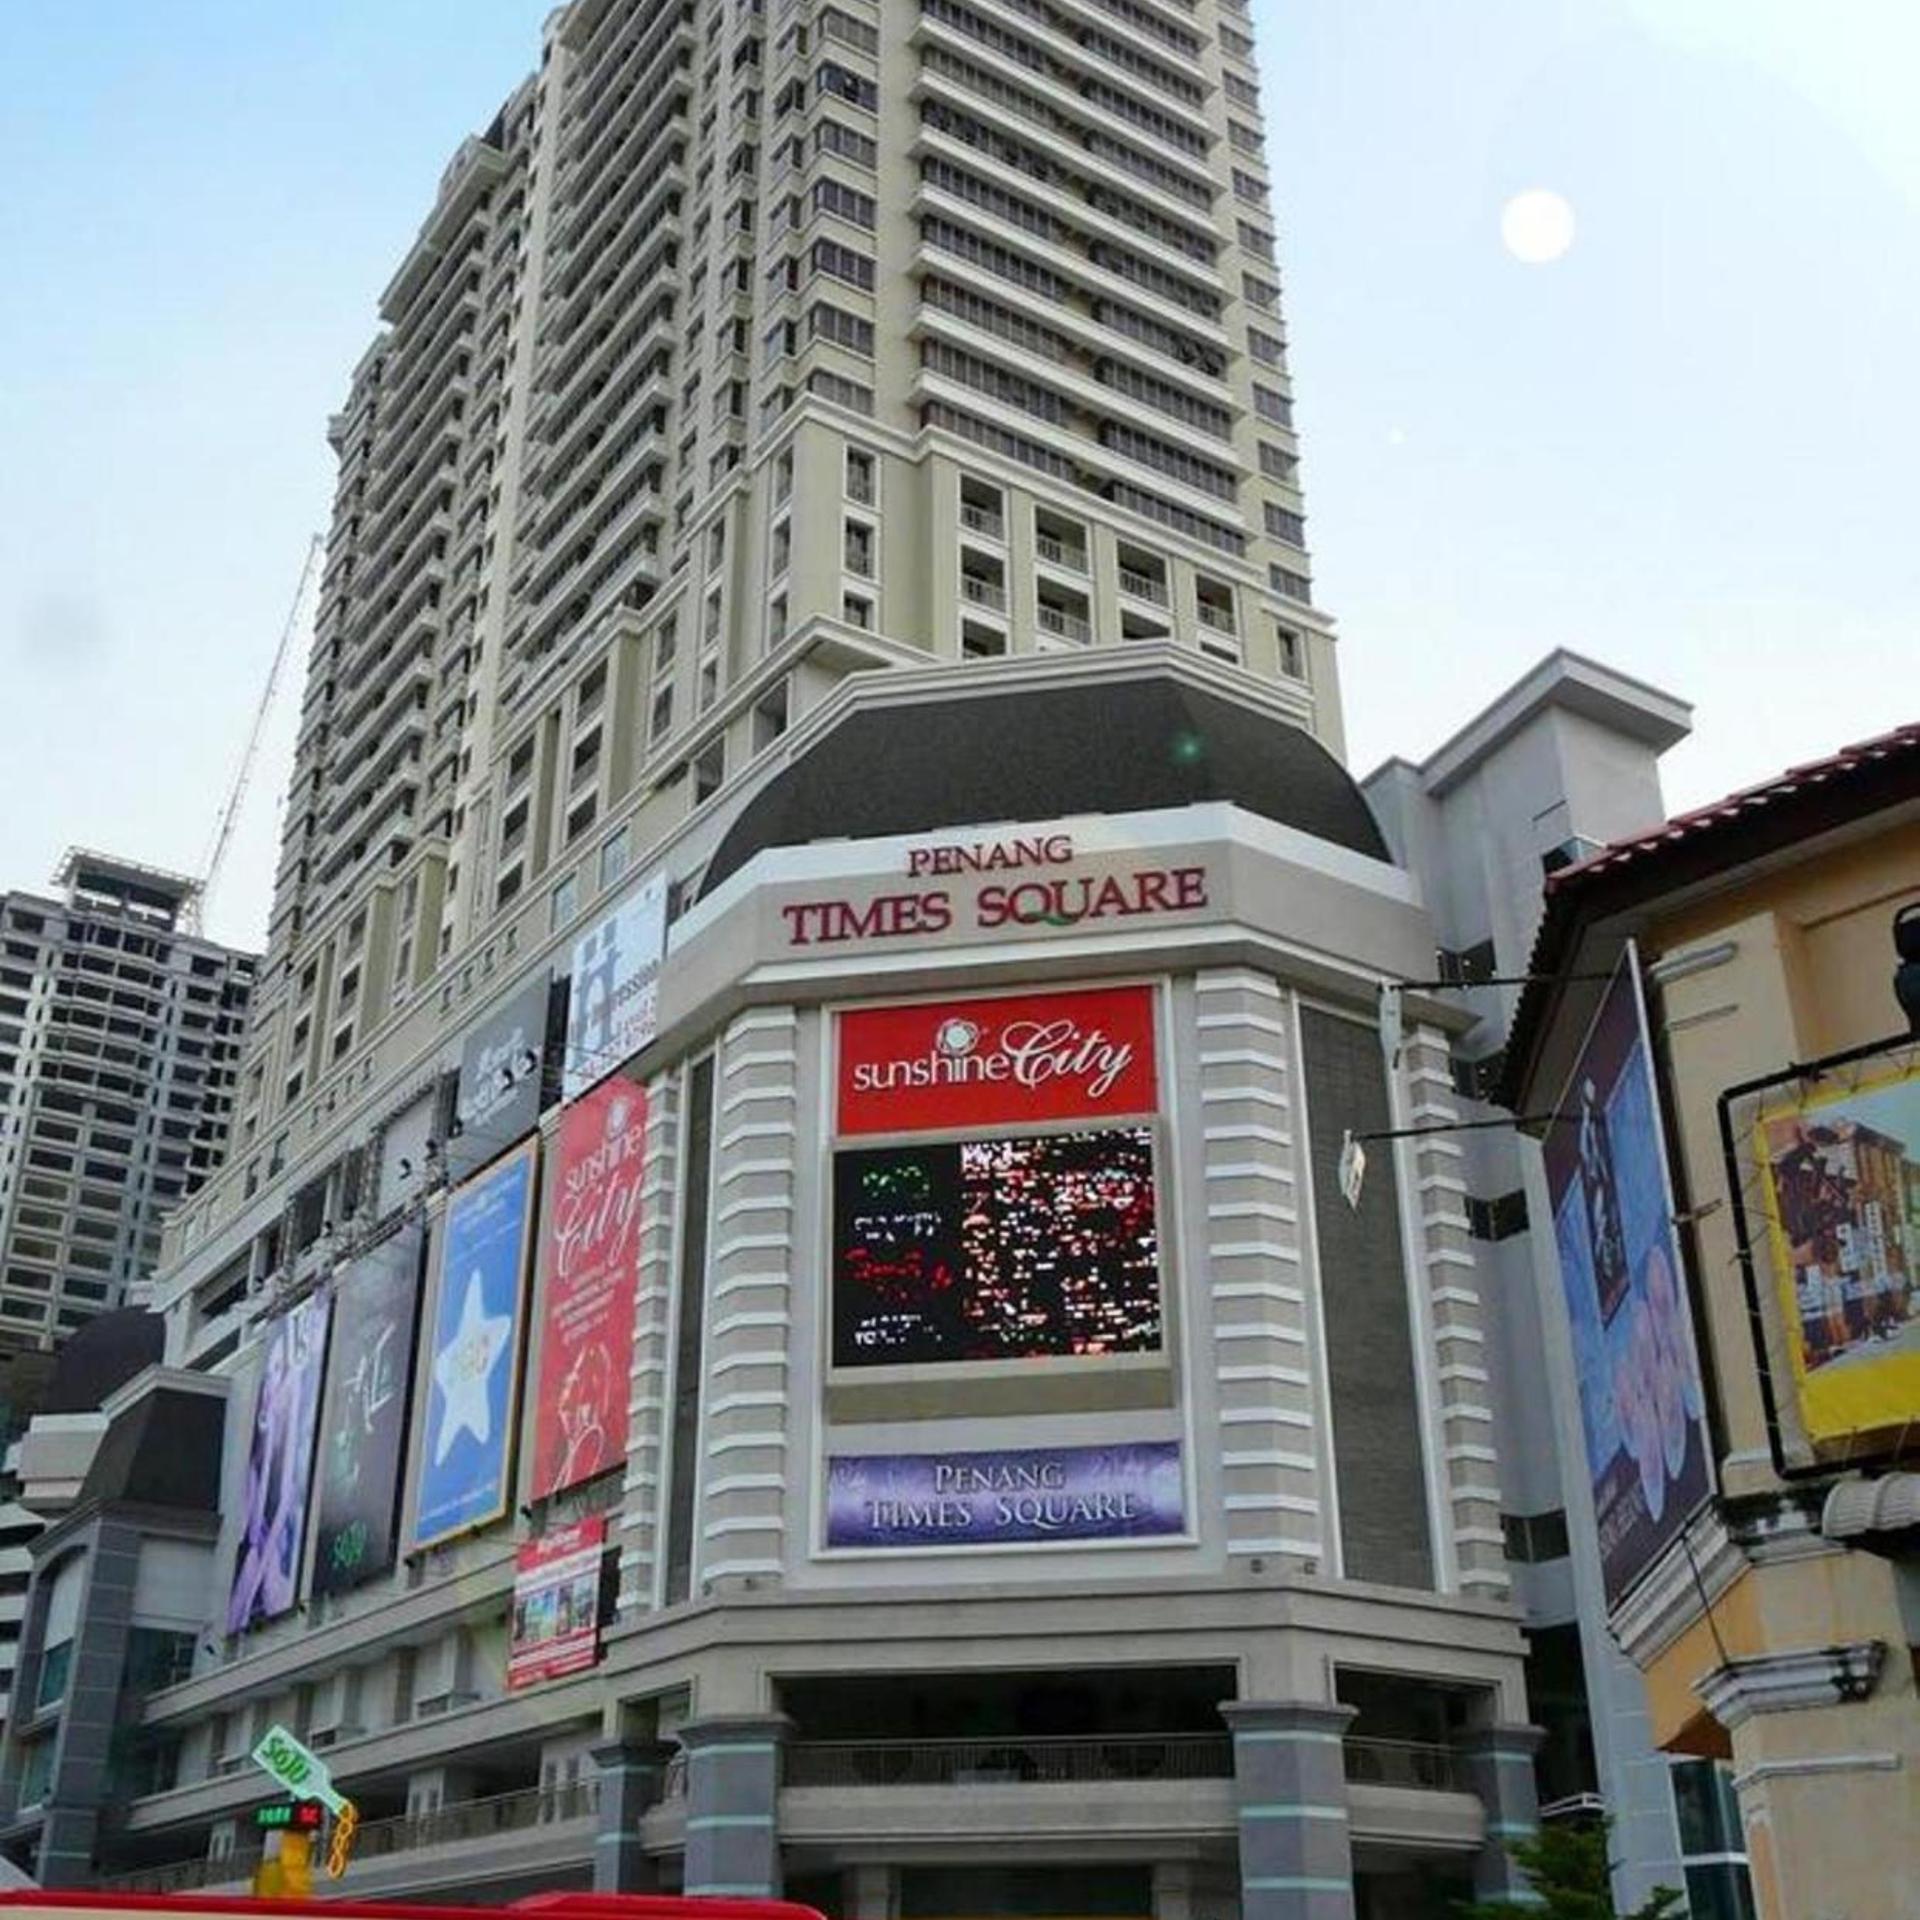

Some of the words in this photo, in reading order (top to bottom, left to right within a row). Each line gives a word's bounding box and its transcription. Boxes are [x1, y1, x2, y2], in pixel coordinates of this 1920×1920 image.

[908, 836, 1073, 877] PENANG
[783, 892, 952, 946] TIMES
[977, 867, 1210, 927] SQUARE
[853, 1049, 1010, 1091] sunshine
[1001, 1018, 1132, 1097] City
